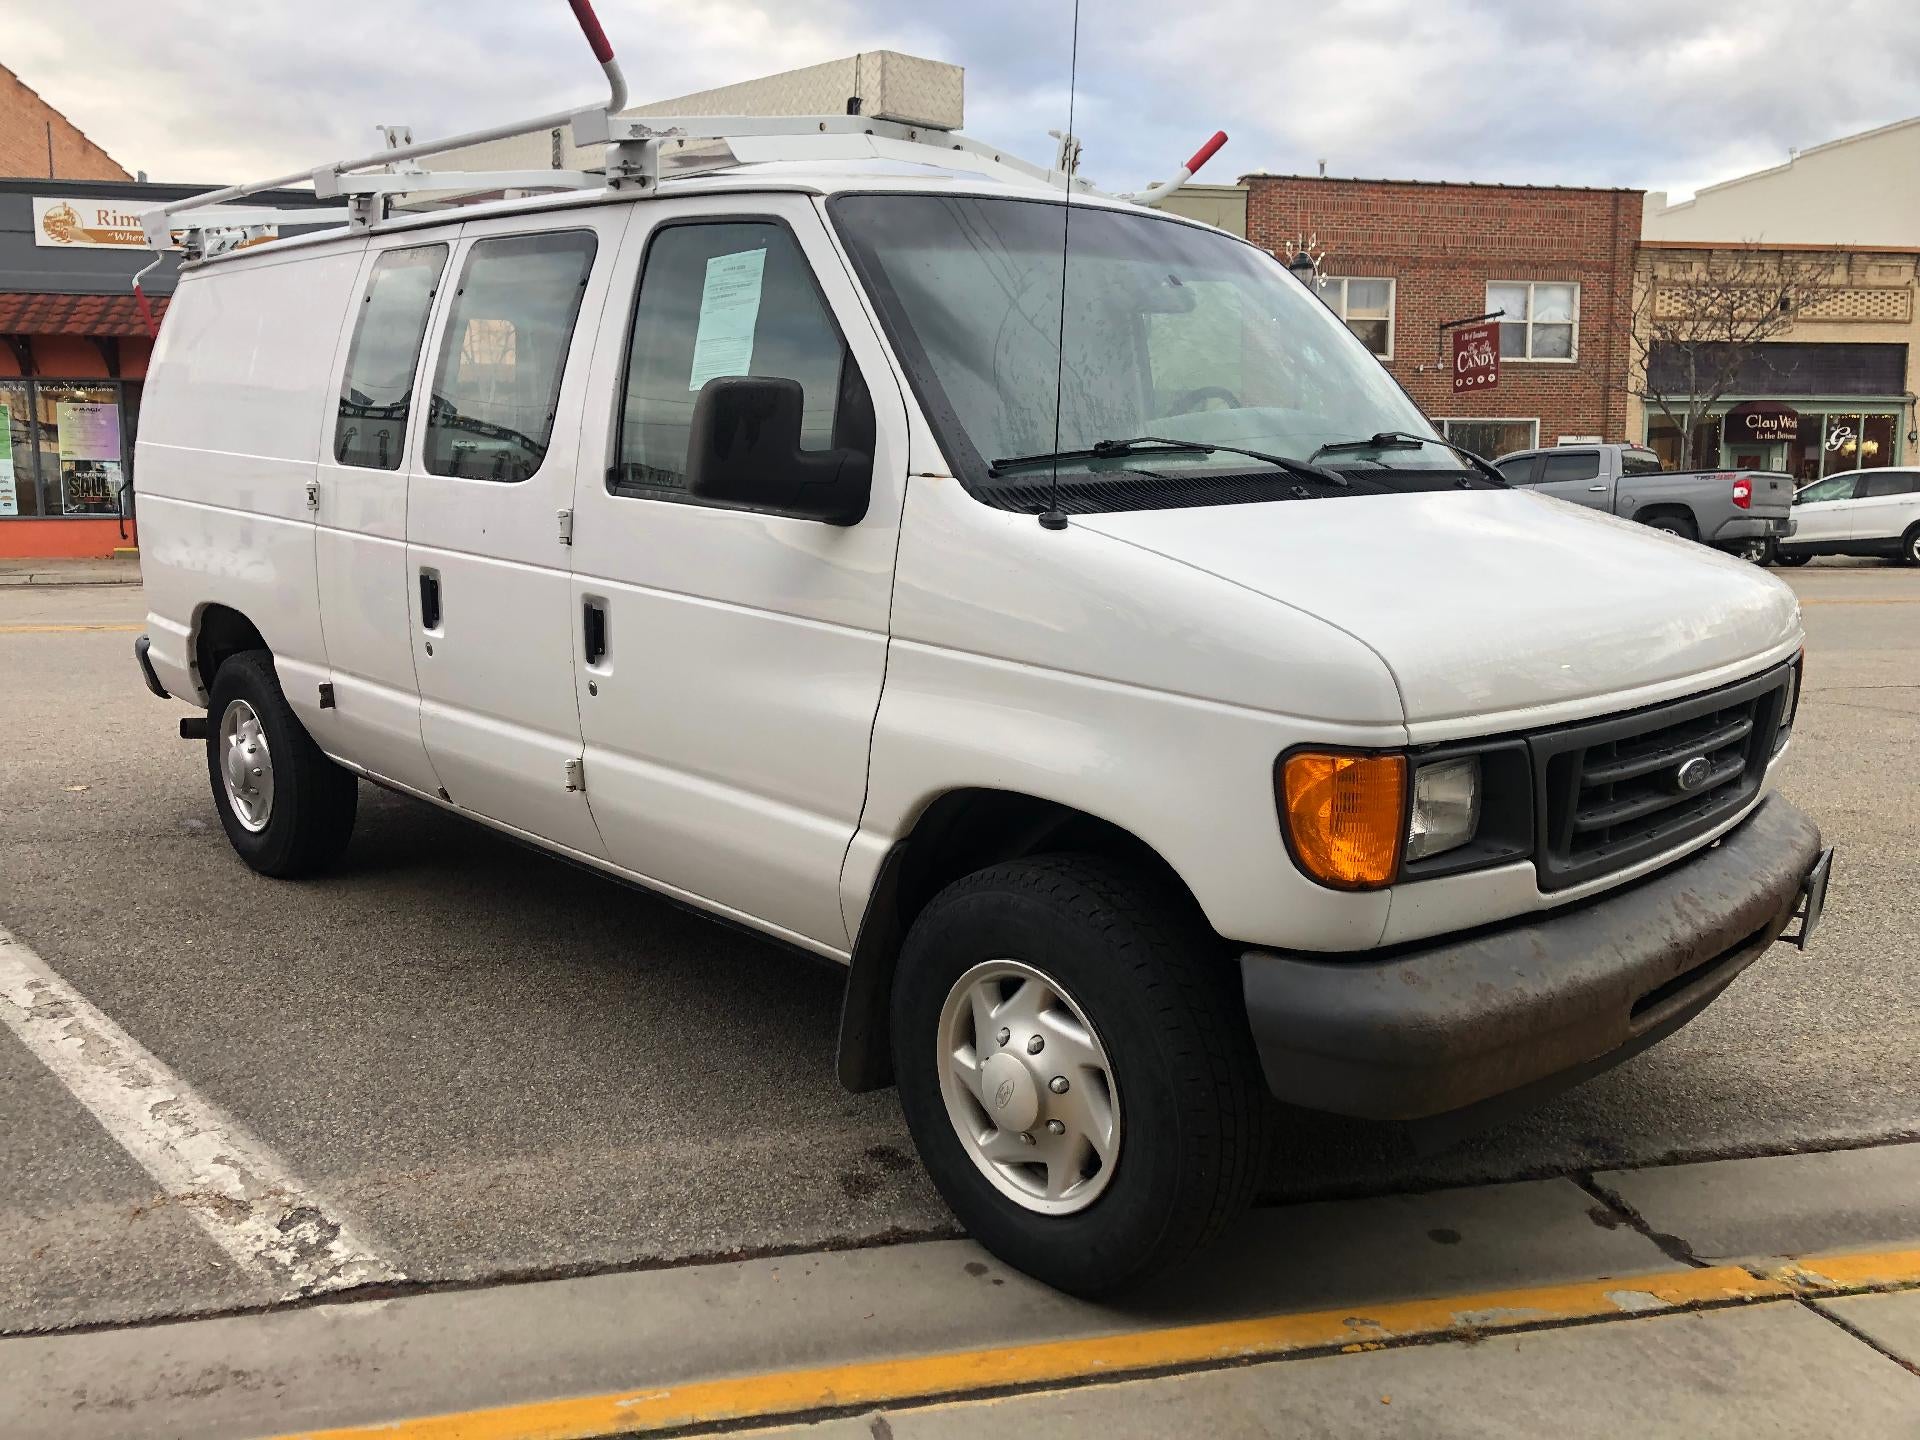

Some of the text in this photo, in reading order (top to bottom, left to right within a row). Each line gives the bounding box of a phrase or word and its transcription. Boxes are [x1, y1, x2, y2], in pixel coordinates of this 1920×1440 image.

[96, 208, 143, 227] Rim
[1457, 351, 1497, 373] CANDY
[80, 385, 114, 394] Airplanes
[1745, 414, 1778, 430] Clay
[1764, 431, 1776, 440] the
